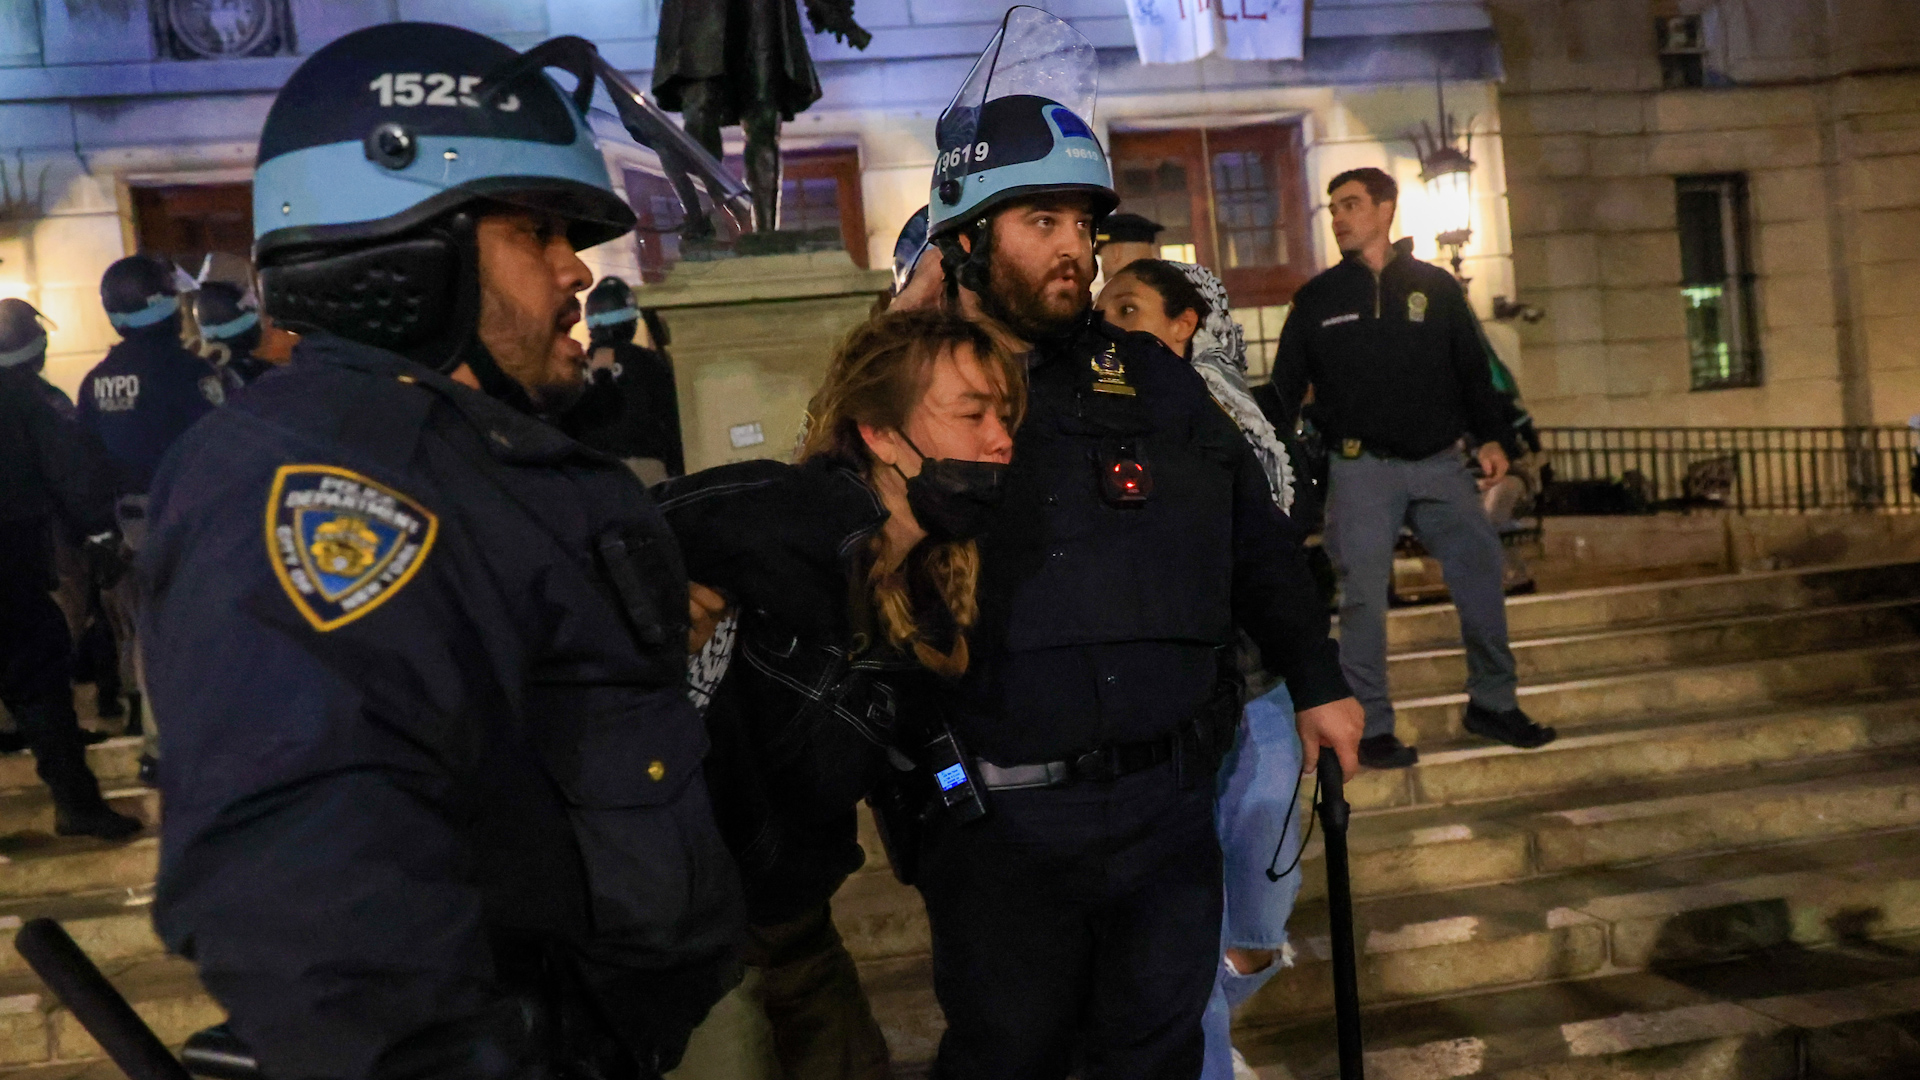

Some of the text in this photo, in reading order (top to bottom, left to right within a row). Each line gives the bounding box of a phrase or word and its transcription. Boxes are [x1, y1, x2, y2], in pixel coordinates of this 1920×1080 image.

[936, 141, 990, 176] 19619
[1065, 148, 1099, 161] 19619
[94, 374, 140, 399] NYPD
[320, 477, 397, 508] POLICE
[285, 490, 419, 533] DEPARTMENT
[340, 581, 382, 611] NEW
